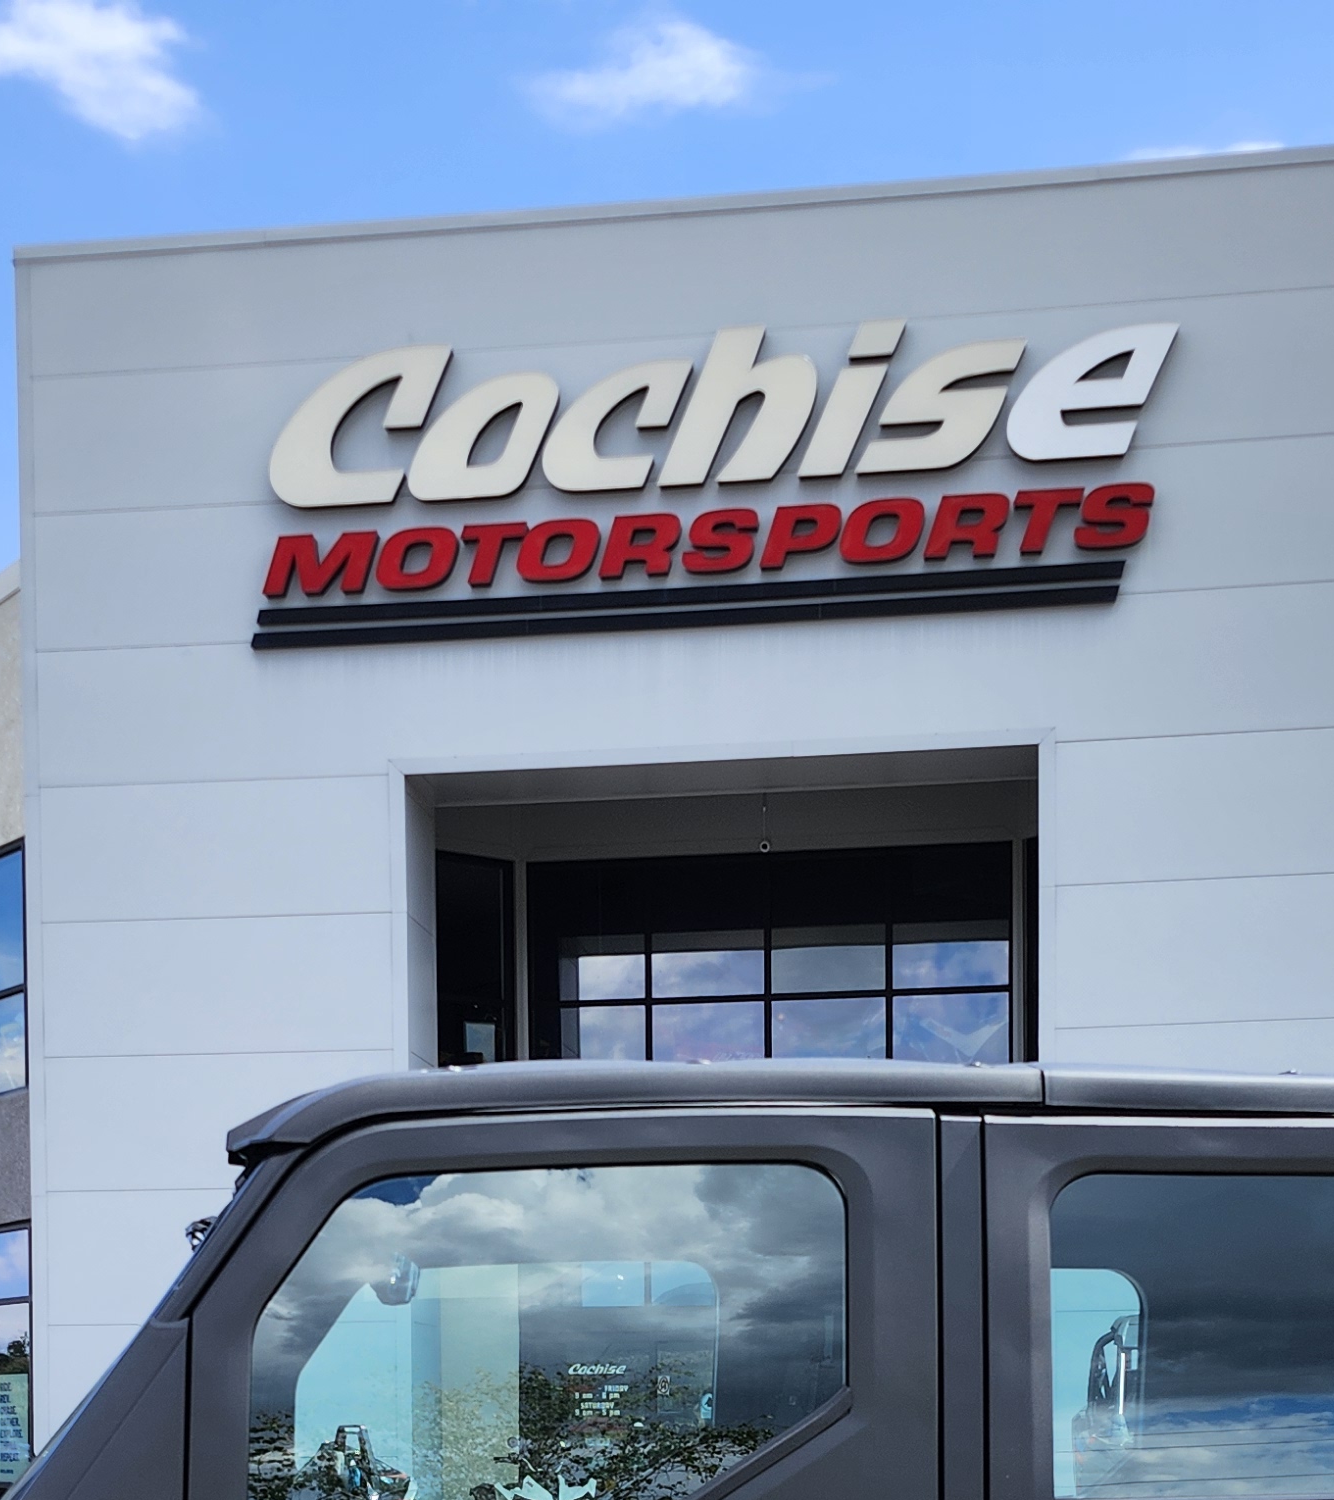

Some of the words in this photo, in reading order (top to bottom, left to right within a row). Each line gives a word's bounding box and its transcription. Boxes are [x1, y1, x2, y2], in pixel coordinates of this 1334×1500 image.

[268, 319, 1180, 508] Cochise
[261, 482, 1155, 599] MOTORSPORTS
[568, 1363, 627, 1375] Cochise
